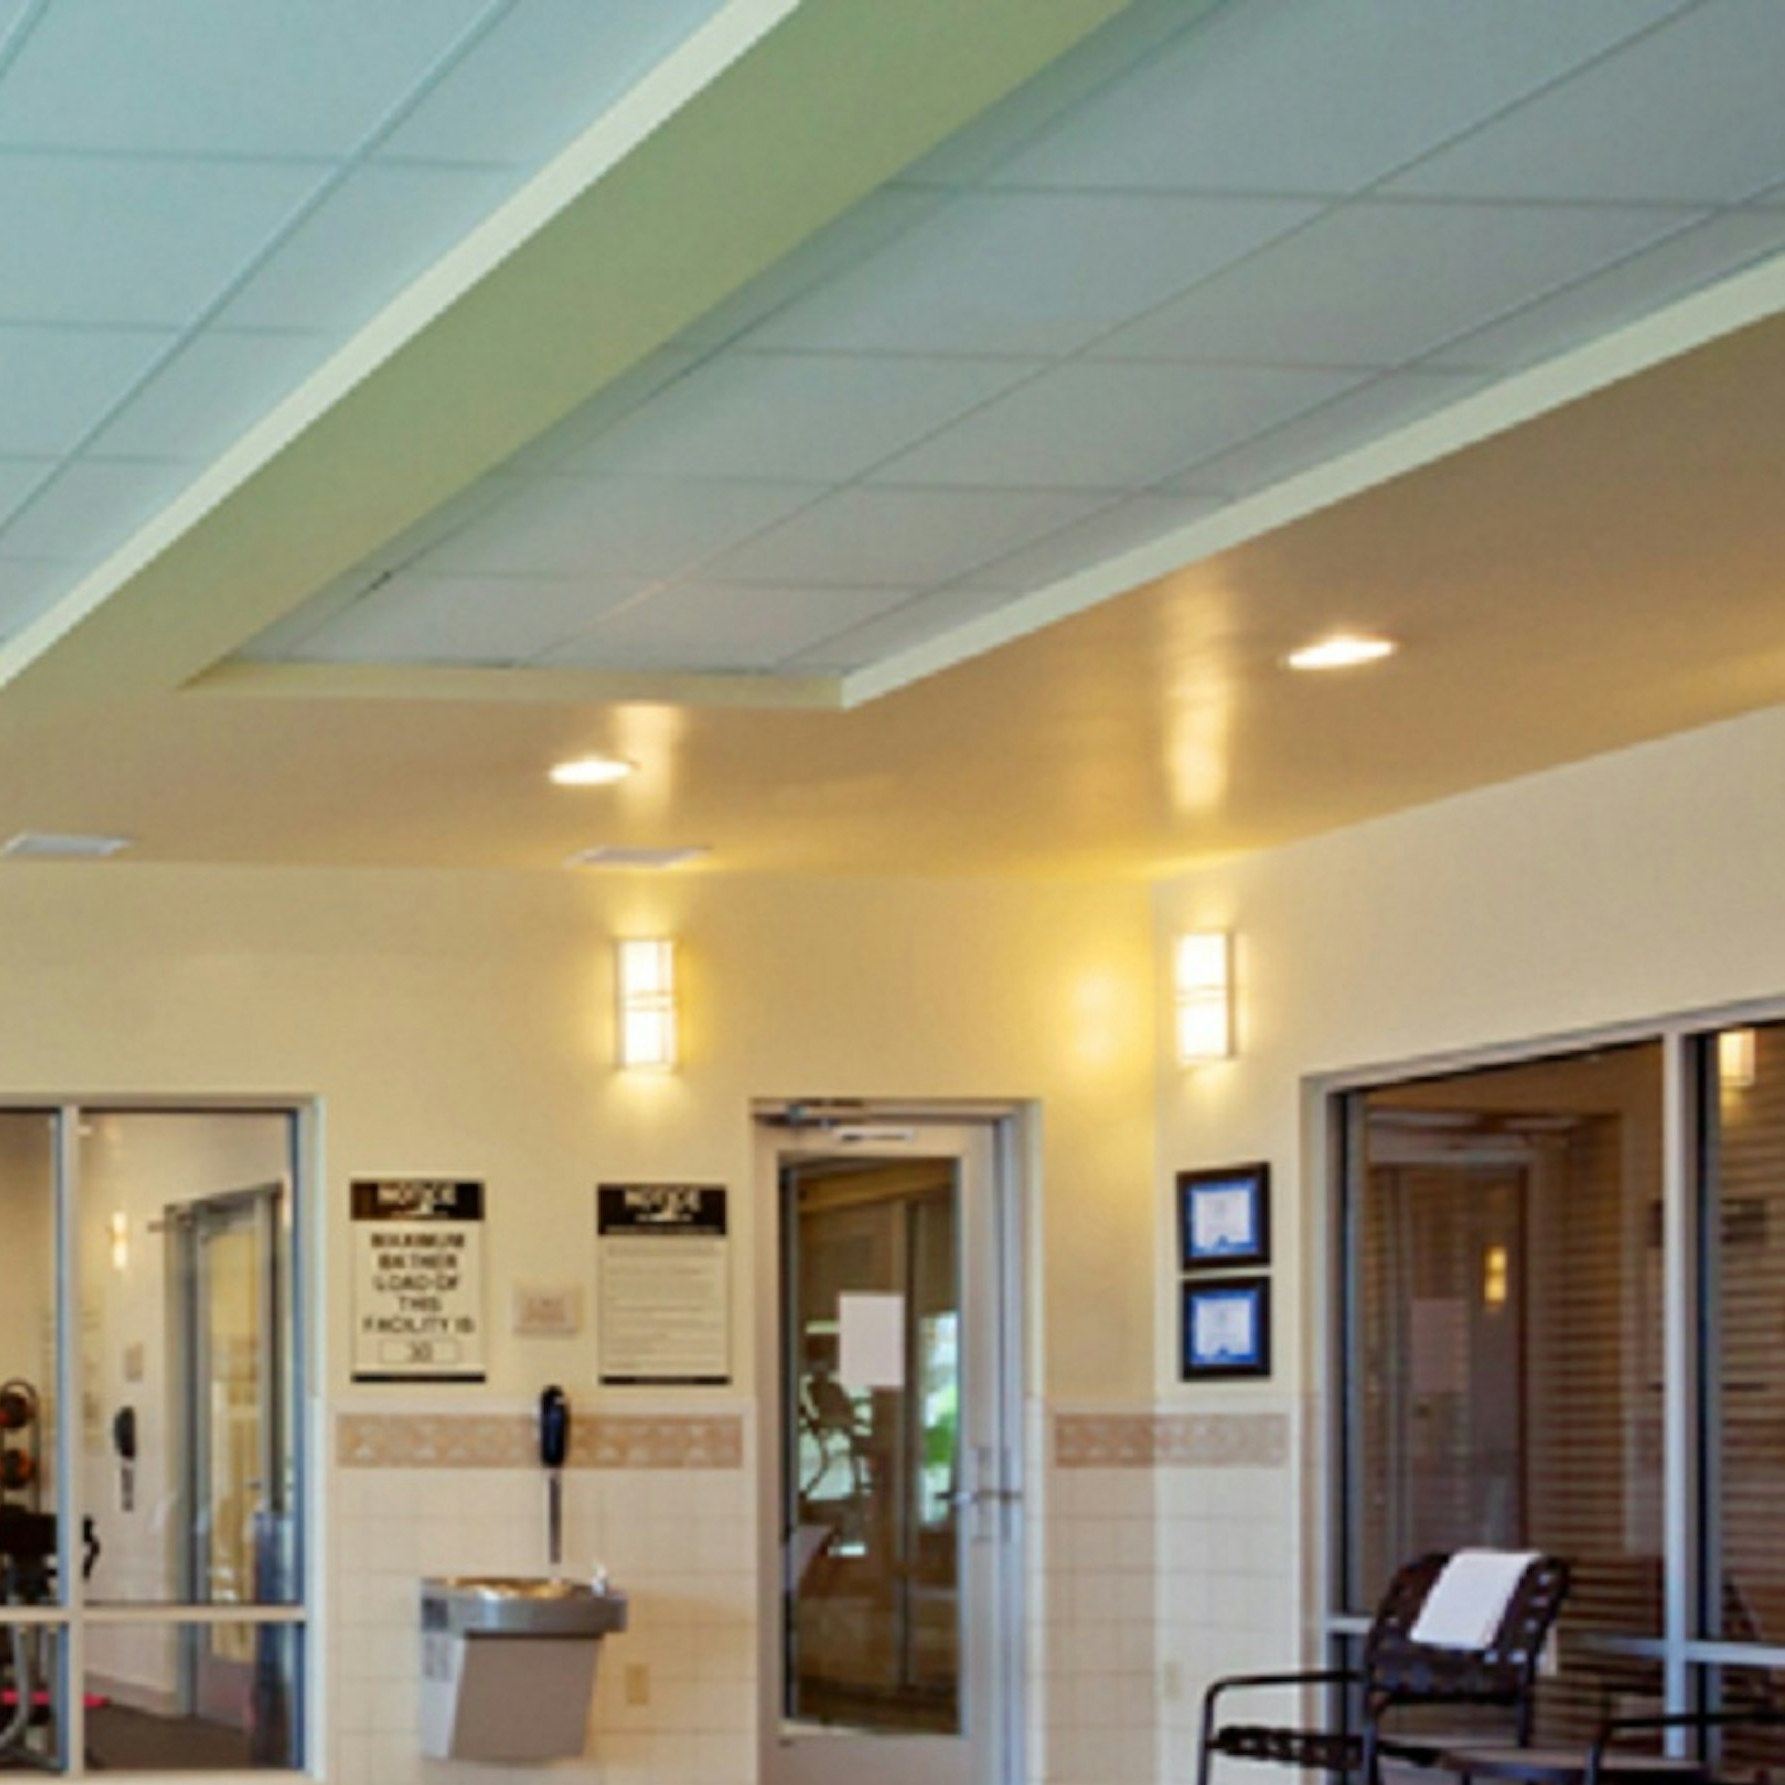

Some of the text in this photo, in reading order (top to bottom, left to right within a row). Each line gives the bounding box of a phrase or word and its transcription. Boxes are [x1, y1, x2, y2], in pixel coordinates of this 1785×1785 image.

[370, 1233, 465, 1249] MAXIMUM
[377, 1254, 458, 1270] BATHER
[372, 1275, 459, 1291] LOAD OF
[398, 1296, 443, 1312] THIS
[362, 1317, 474, 1334] FACILITY IS
